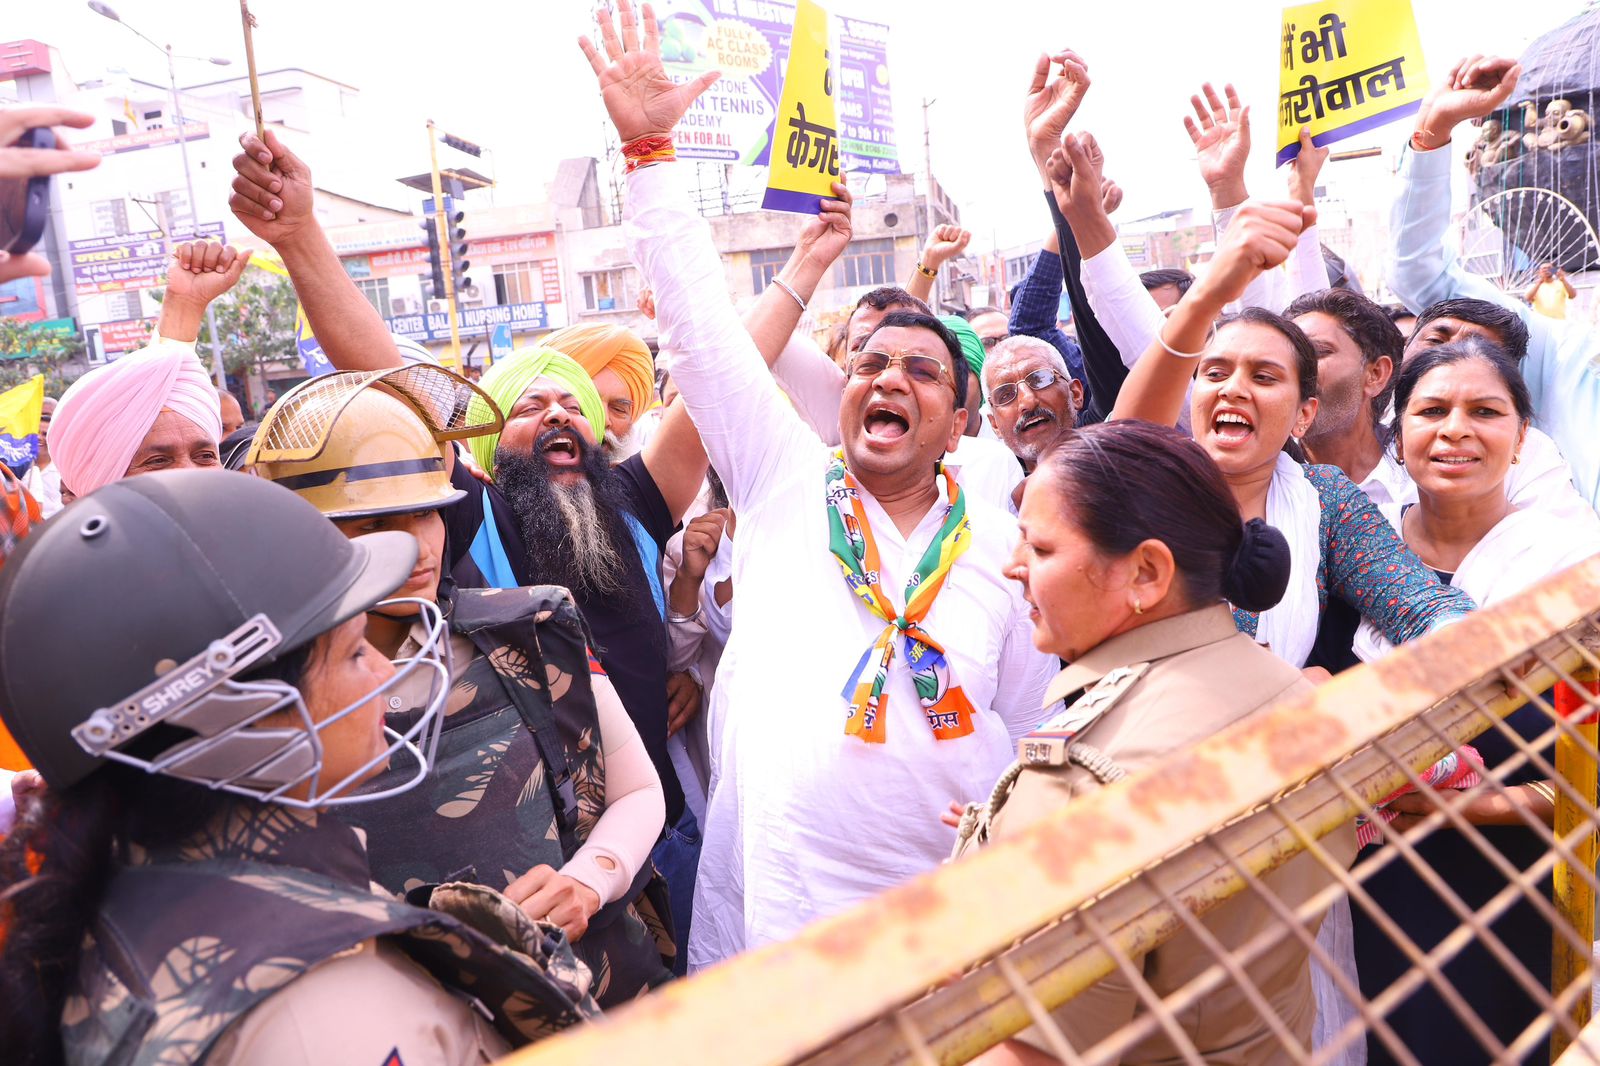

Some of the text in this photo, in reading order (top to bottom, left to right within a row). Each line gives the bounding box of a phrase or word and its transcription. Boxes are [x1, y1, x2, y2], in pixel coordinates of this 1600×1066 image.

[717, 26, 752, 40] FULLY
[1300, 13, 1347, 63] भी
[707, 36, 724, 50] AC
[728, 39, 767, 56] CLASS
[718, 52, 759, 68] ROOMS
[710, 96, 765, 115] TENNIS
[680, 113, 723, 128] ADEMY
[671, 131, 732, 146] PEN FOR ALL
[465, 307, 511, 327] NURSING
[512, 304, 543, 322] HOME
[393, 316, 425, 334] CENTER
[142, 663, 214, 715] SHREY
